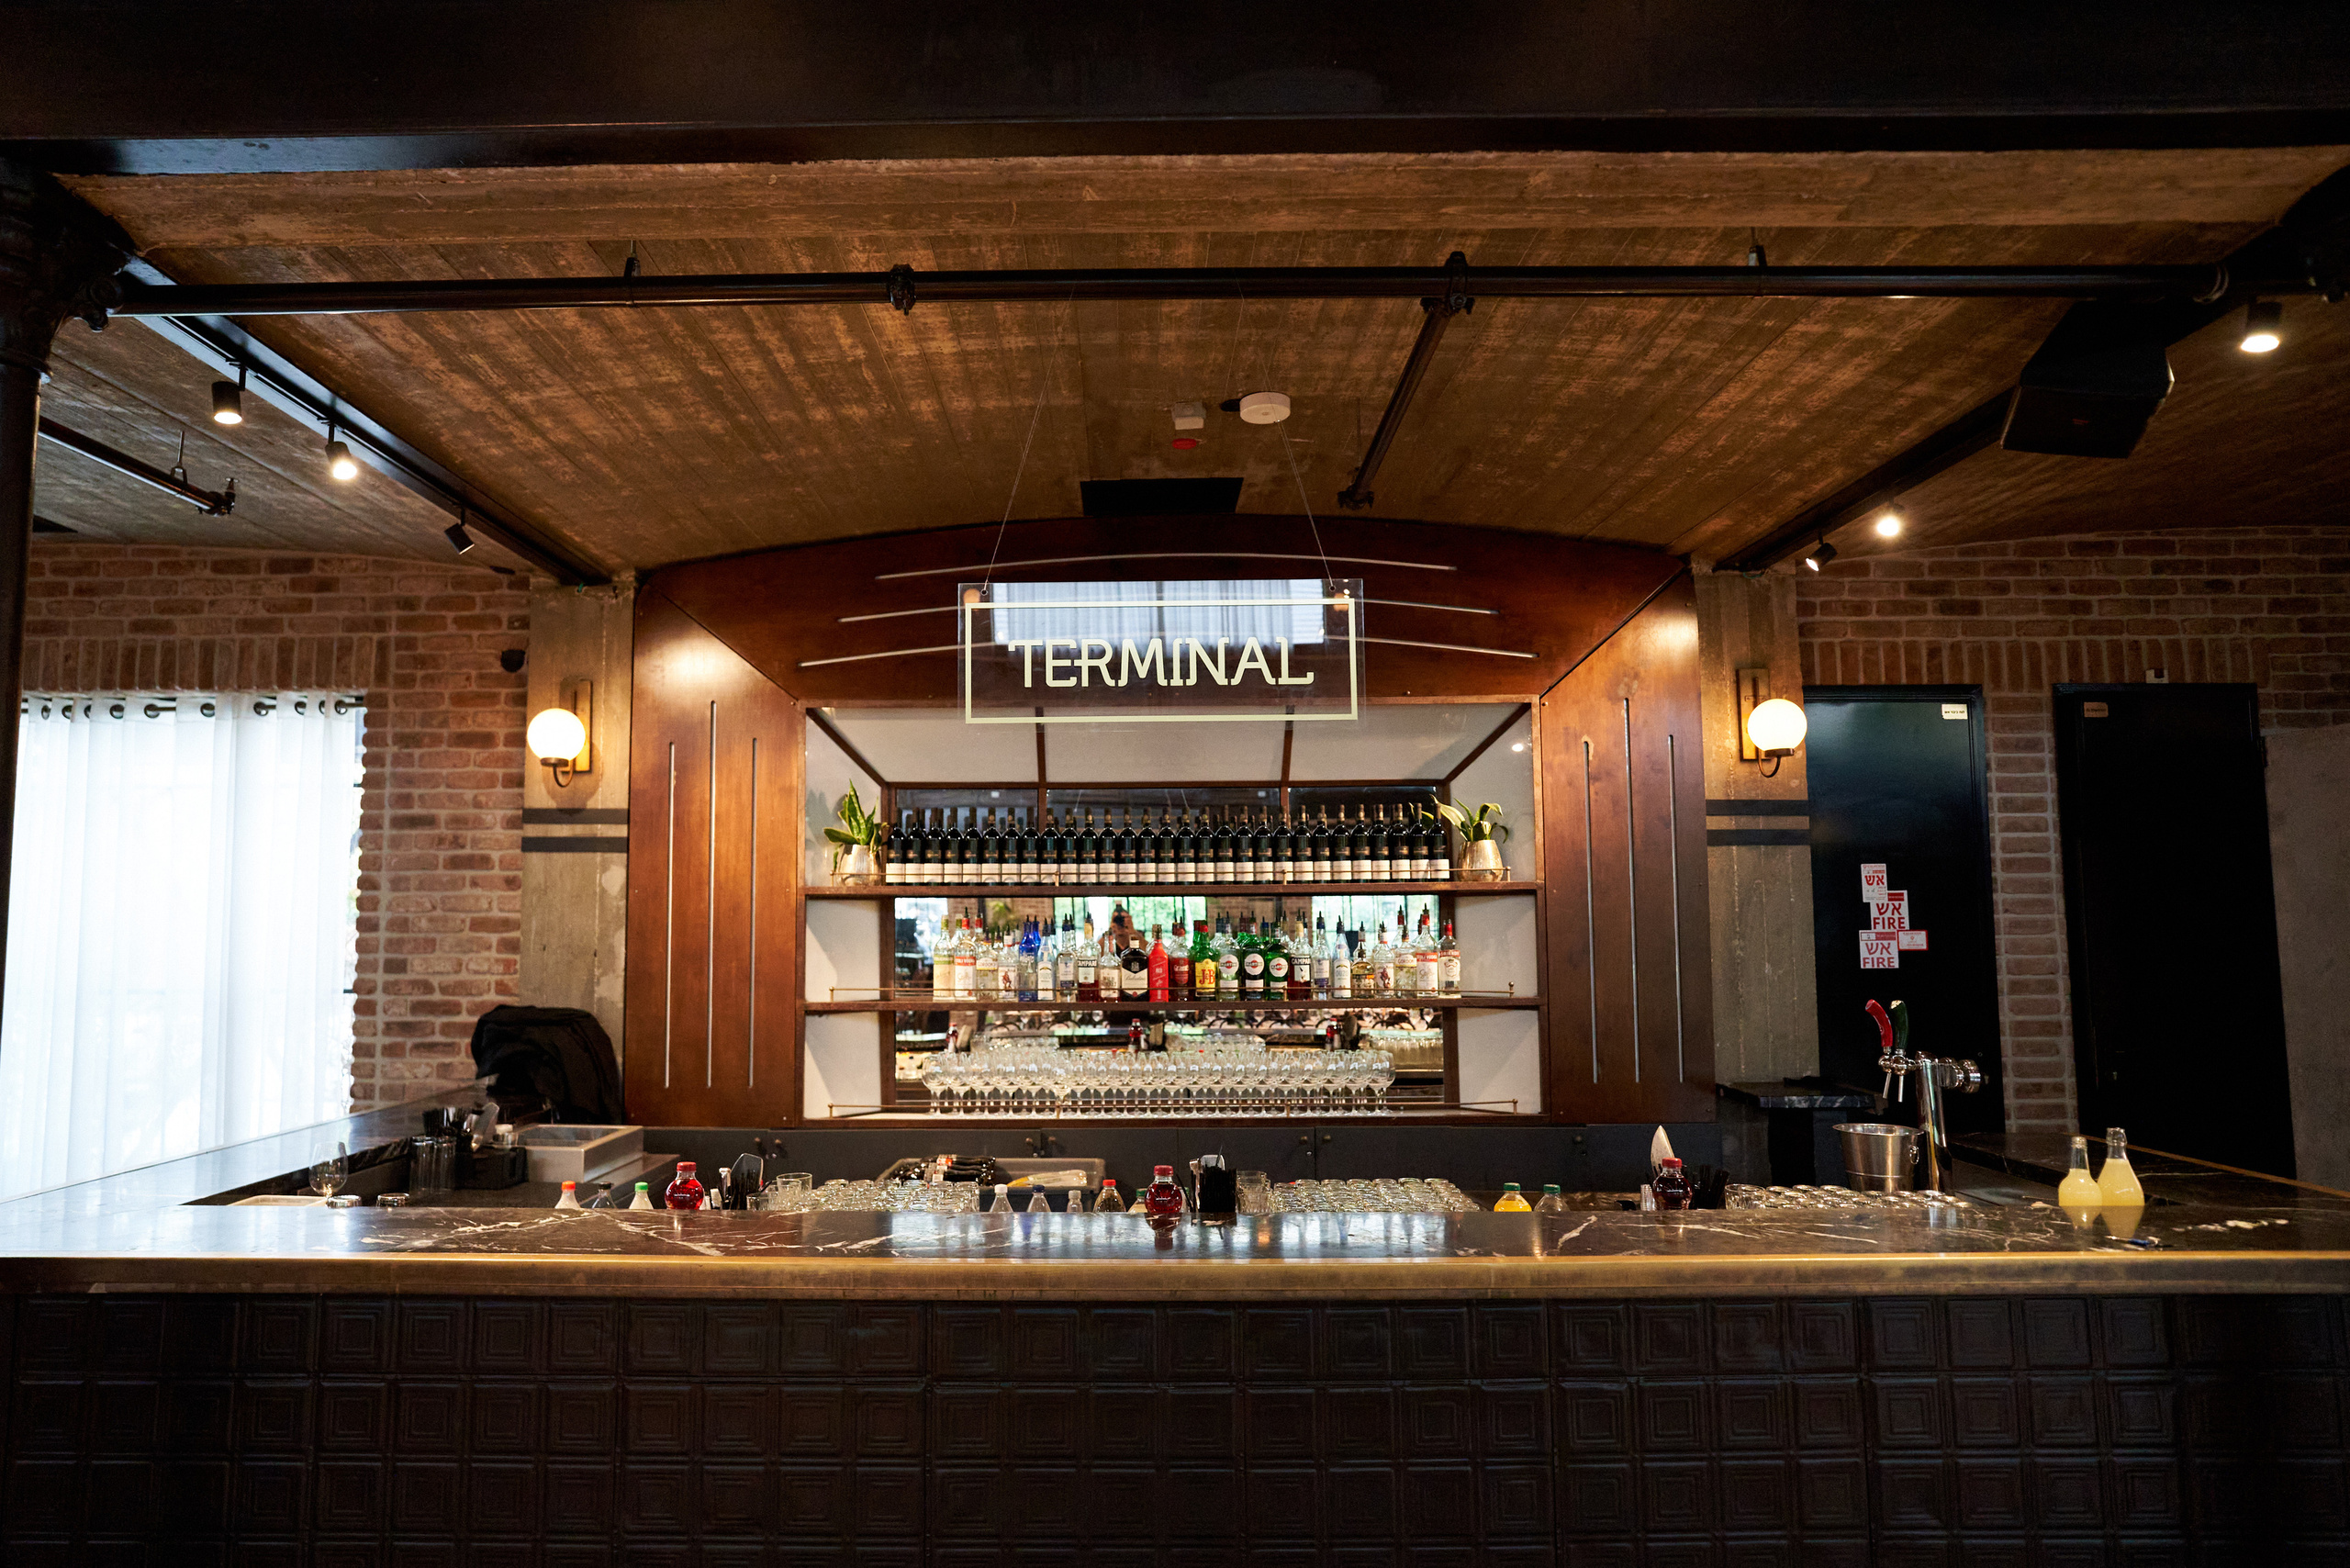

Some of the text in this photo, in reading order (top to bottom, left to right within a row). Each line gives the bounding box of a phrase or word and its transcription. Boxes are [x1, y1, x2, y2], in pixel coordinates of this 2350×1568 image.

[1008, 636, 1315, 688] TERMINAL
[1864, 875, 1885, 886] אש
[1876, 902, 1902, 915] אש
[1873, 917, 1906, 930] FIRE
[1865, 942, 1892, 956] אש
[1863, 957, 1895, 969] FIRE
[1199, 969, 1215, 985] J&B
